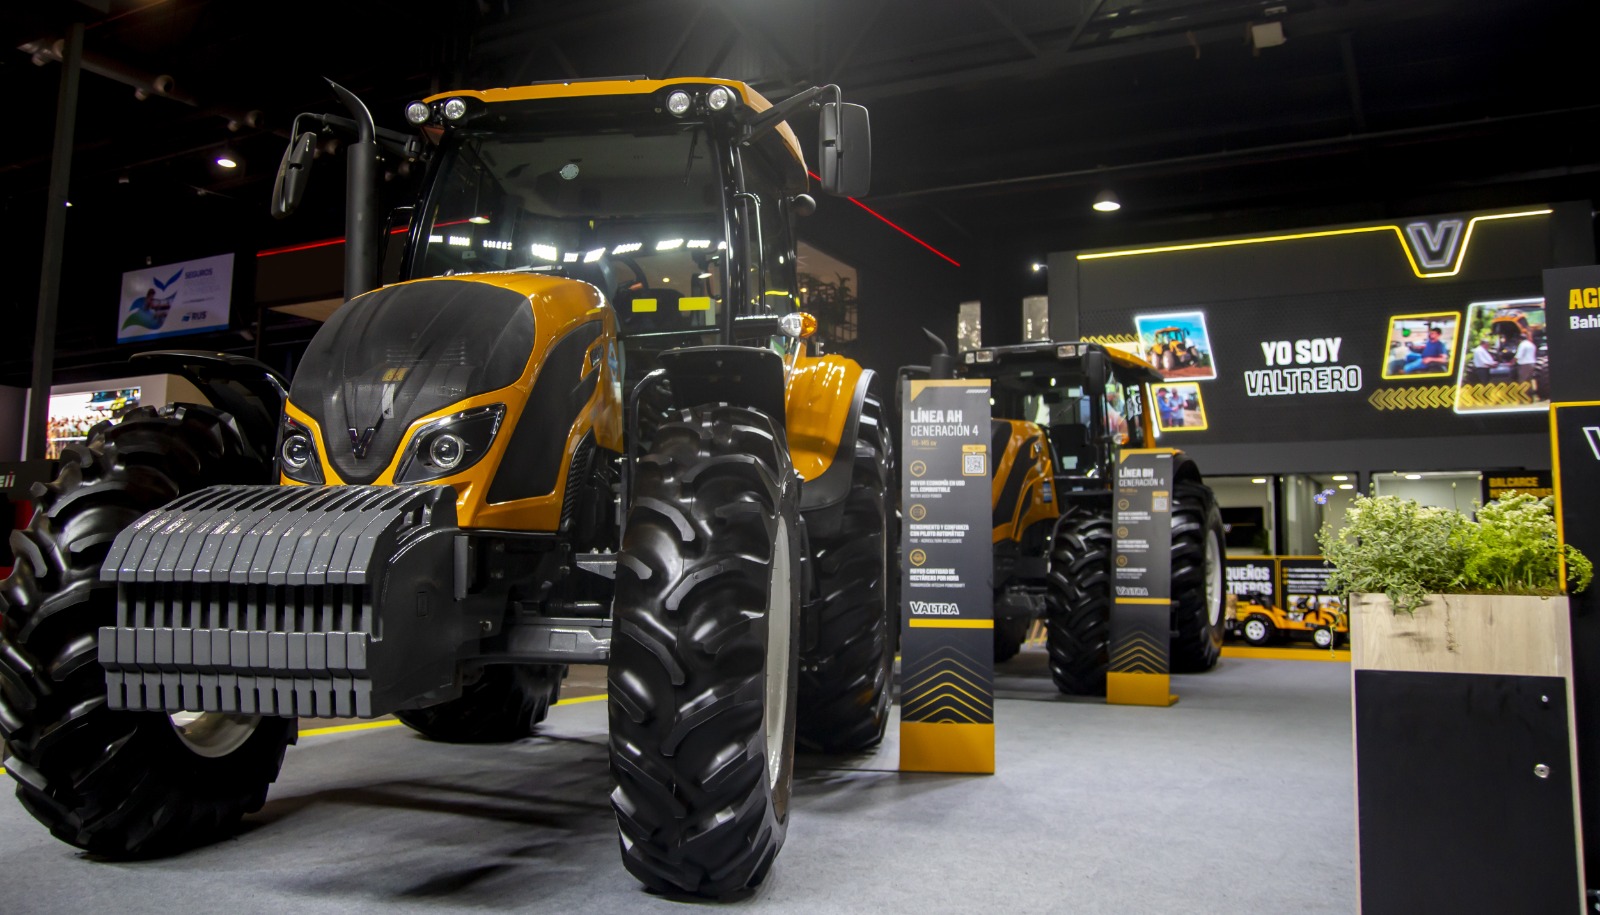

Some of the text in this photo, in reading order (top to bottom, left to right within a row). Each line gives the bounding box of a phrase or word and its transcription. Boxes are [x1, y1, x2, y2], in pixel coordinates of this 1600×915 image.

[1406, 220, 1462, 268] V
[1261, 337, 1342, 366] YO SOY
[1244, 365, 1362, 396] VALTRERO
[910, 407, 963, 423] LÍNEA AH
[910, 423, 979, 437] GENERACIÓN 4
[1119, 467, 1141, 478] LÍNEA
[909, 601, 960, 615] VALTRA
